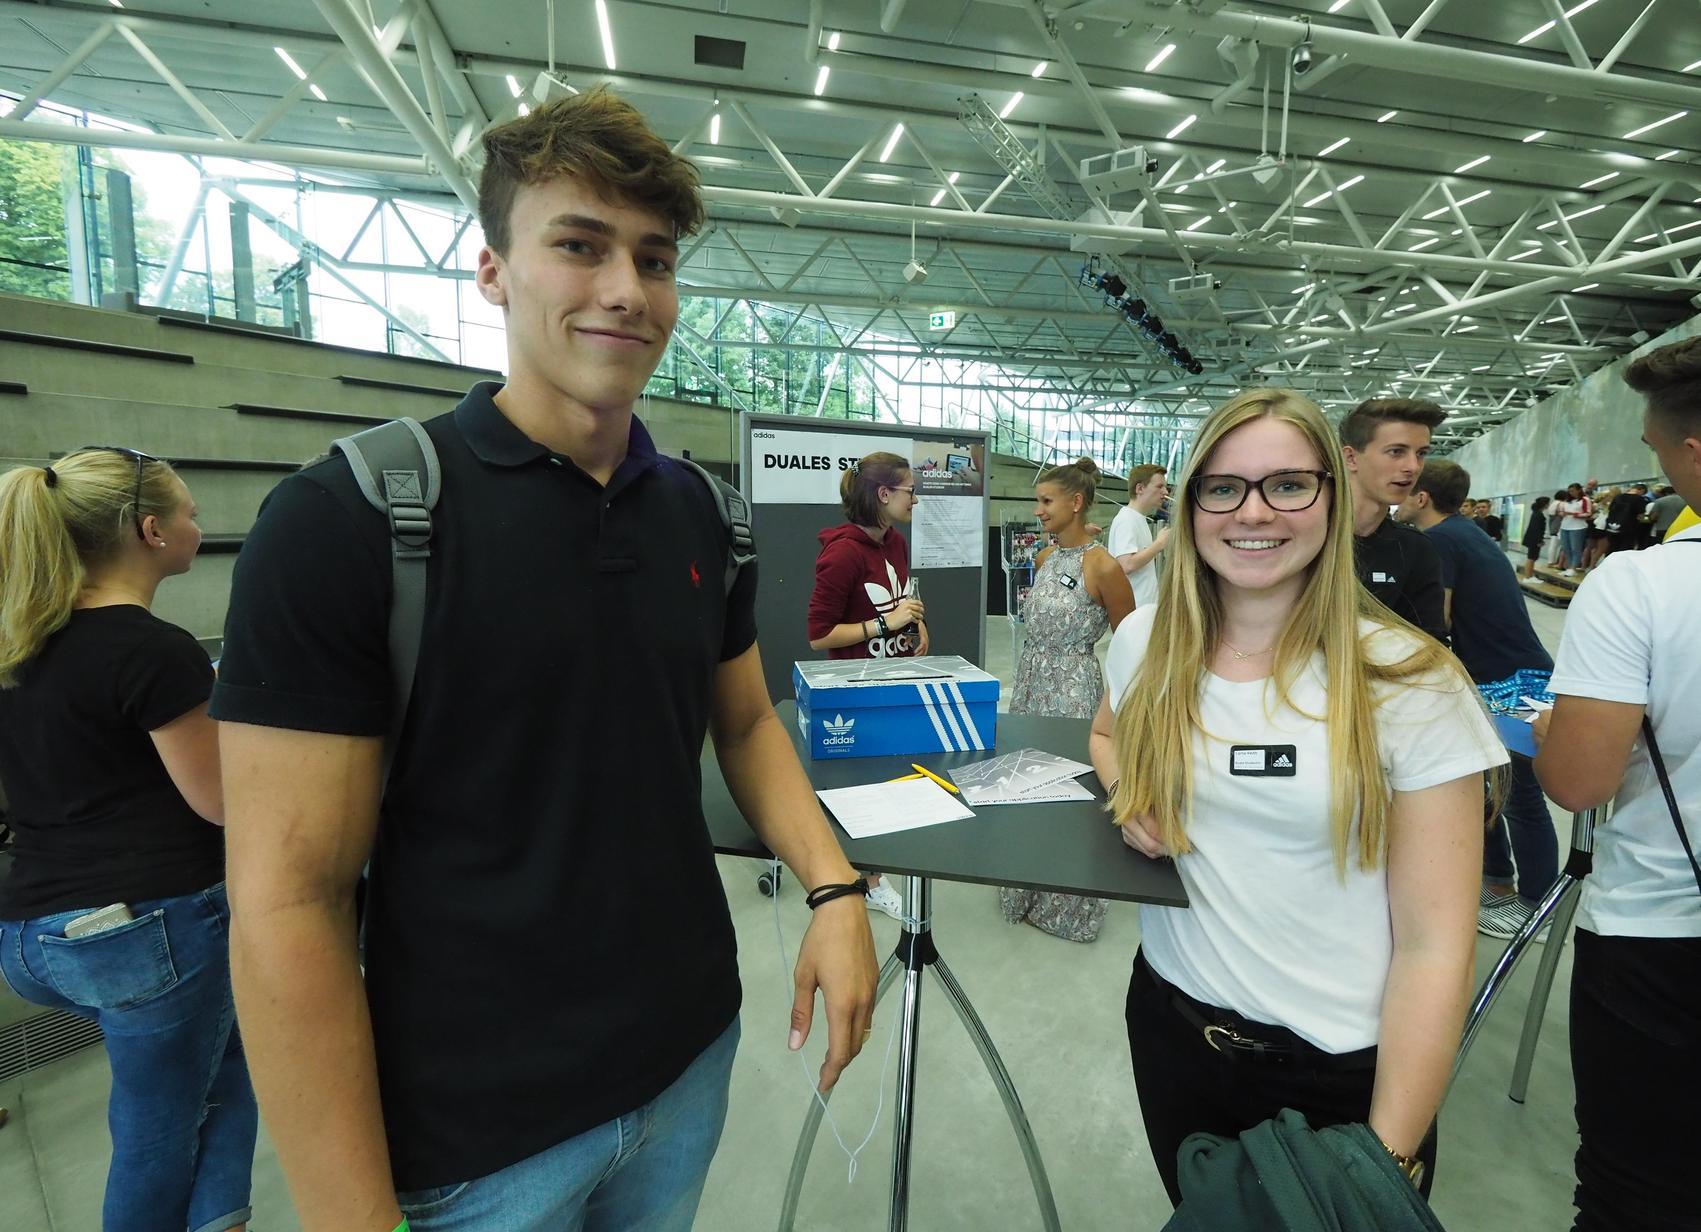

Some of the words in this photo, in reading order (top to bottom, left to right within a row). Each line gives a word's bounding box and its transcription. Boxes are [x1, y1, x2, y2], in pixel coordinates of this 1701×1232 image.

[764, 454, 831, 470] DUALES
[838, 457, 862, 471] ST
[922, 469, 953, 479] adidas
[823, 736, 855, 745] adidas
